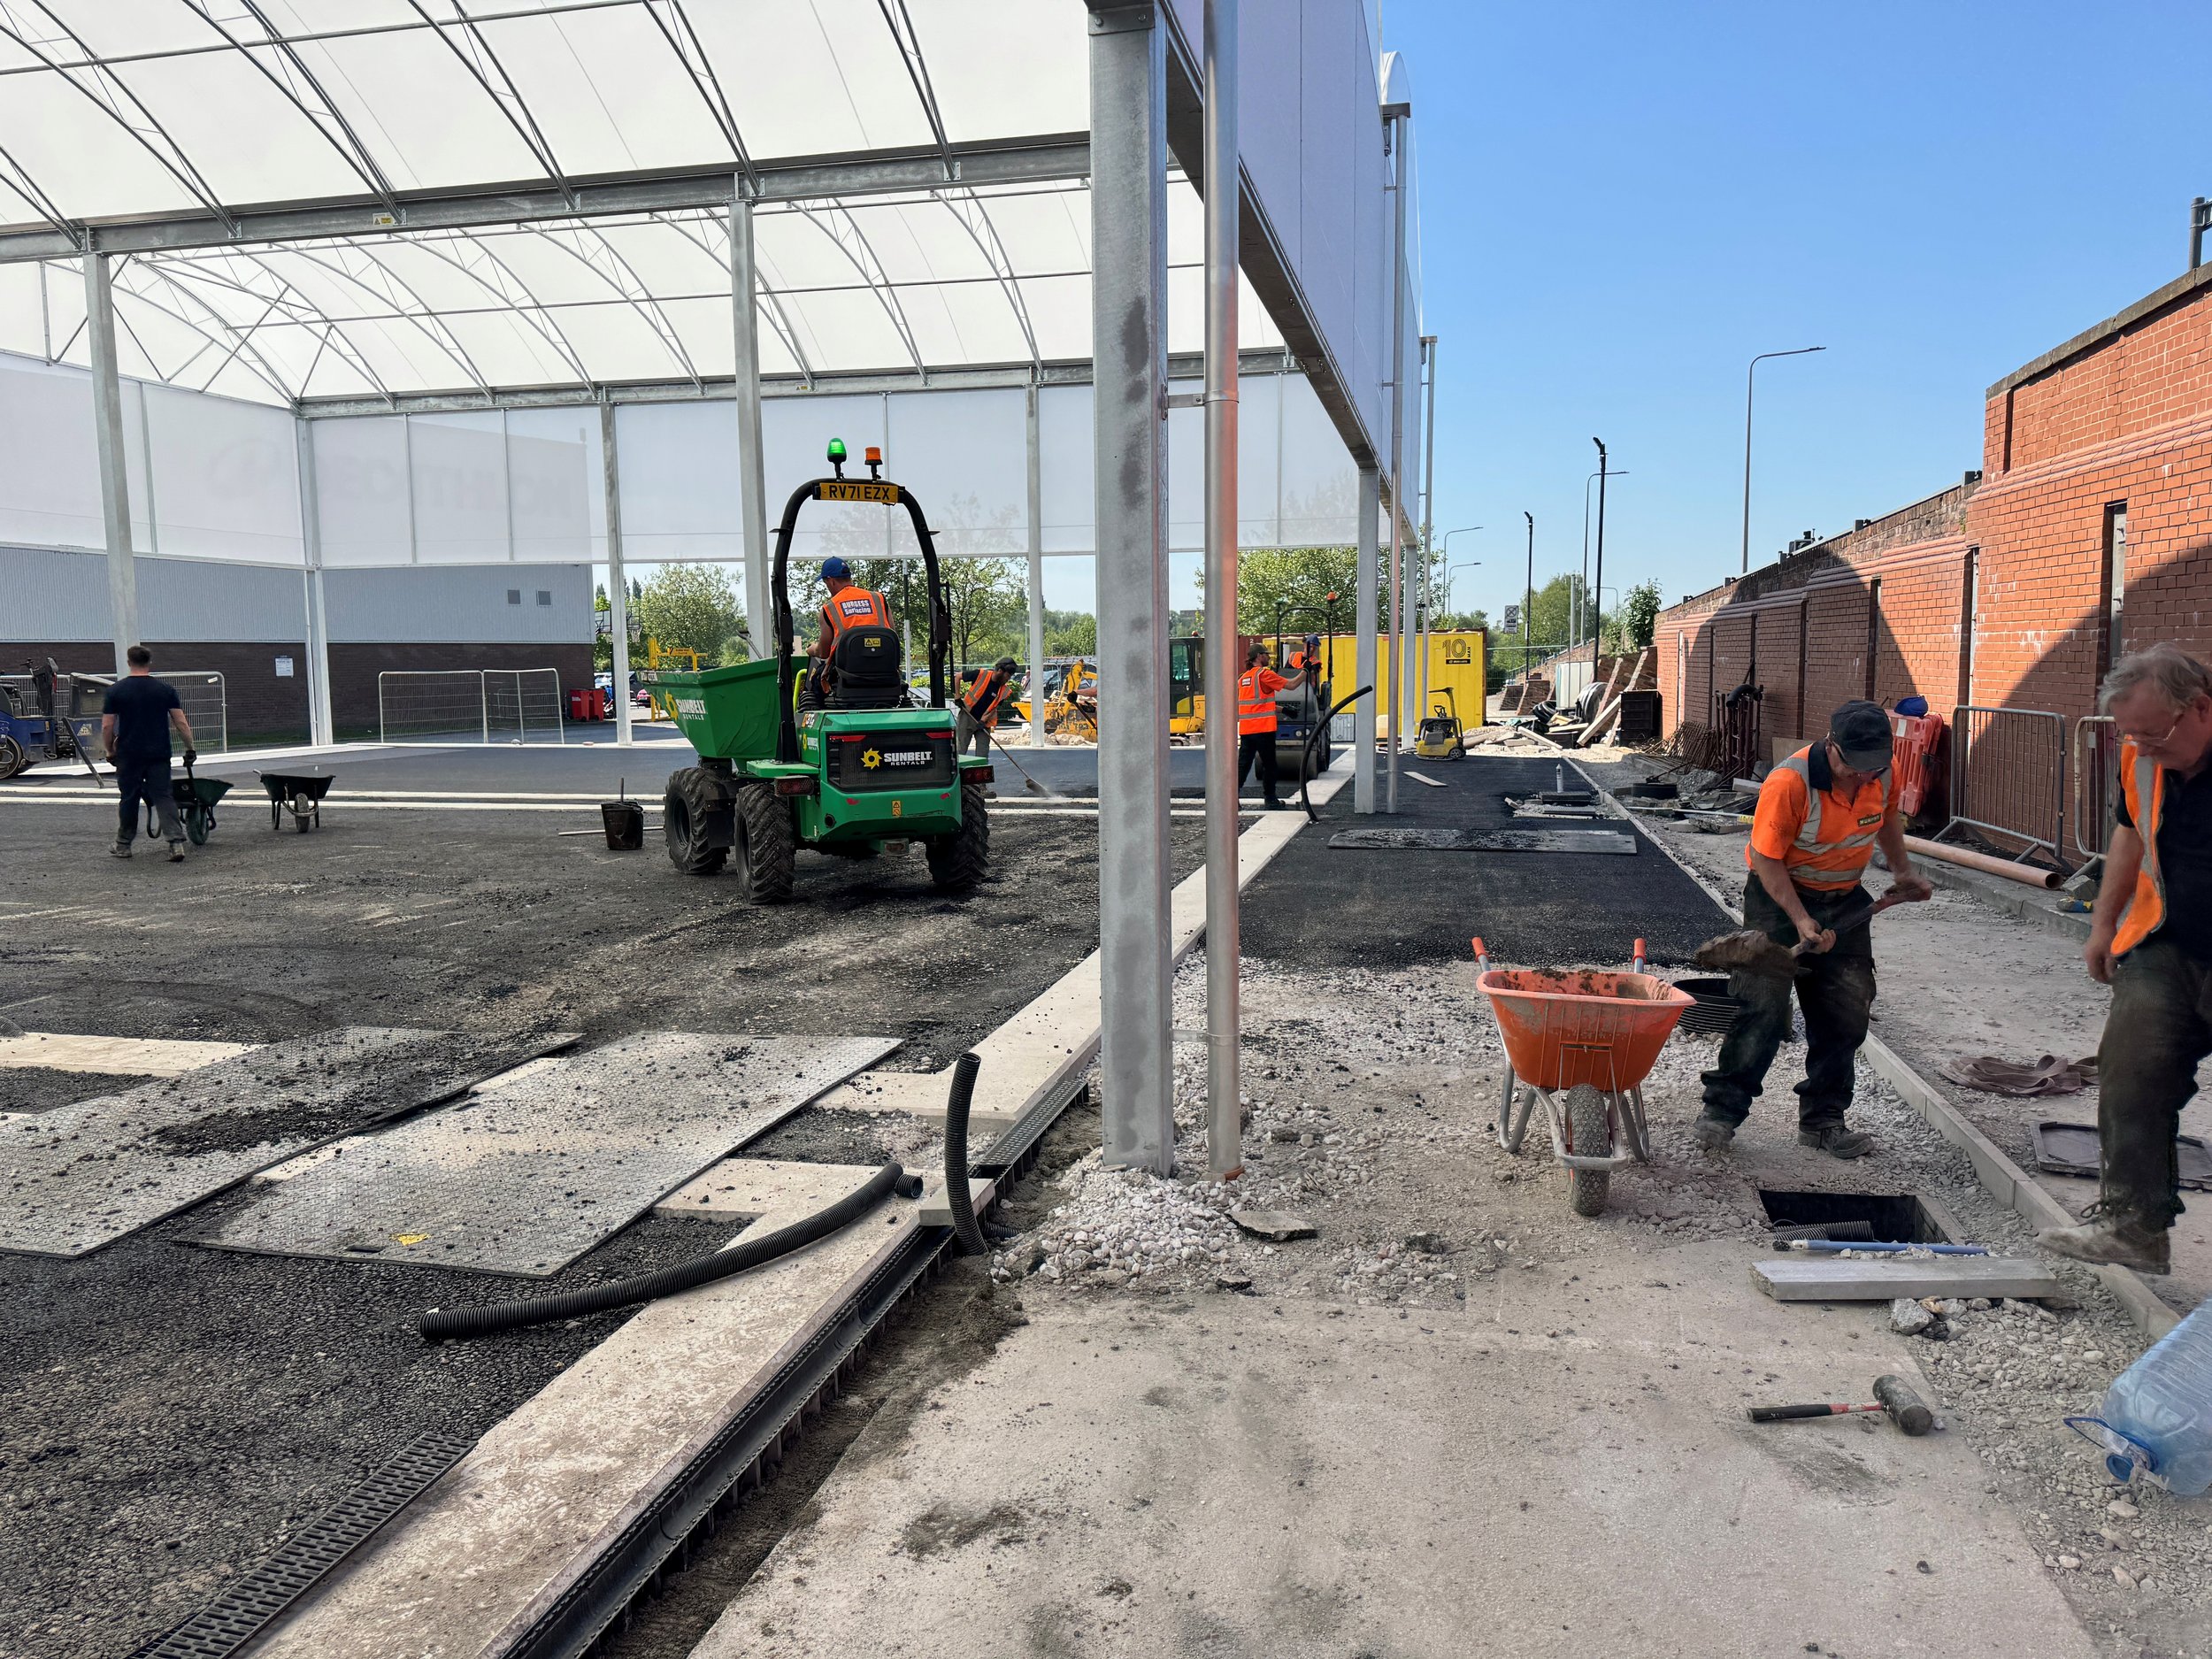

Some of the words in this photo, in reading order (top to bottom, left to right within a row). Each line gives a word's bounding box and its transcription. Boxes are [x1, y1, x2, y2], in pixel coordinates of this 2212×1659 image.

[829, 485, 860, 499] RV71
[864, 487, 890, 500] EZX
[1442, 639, 1466, 658] 10
[675, 699, 706, 714] SUNBELT
[884, 751, 932, 763] SUNBELT
